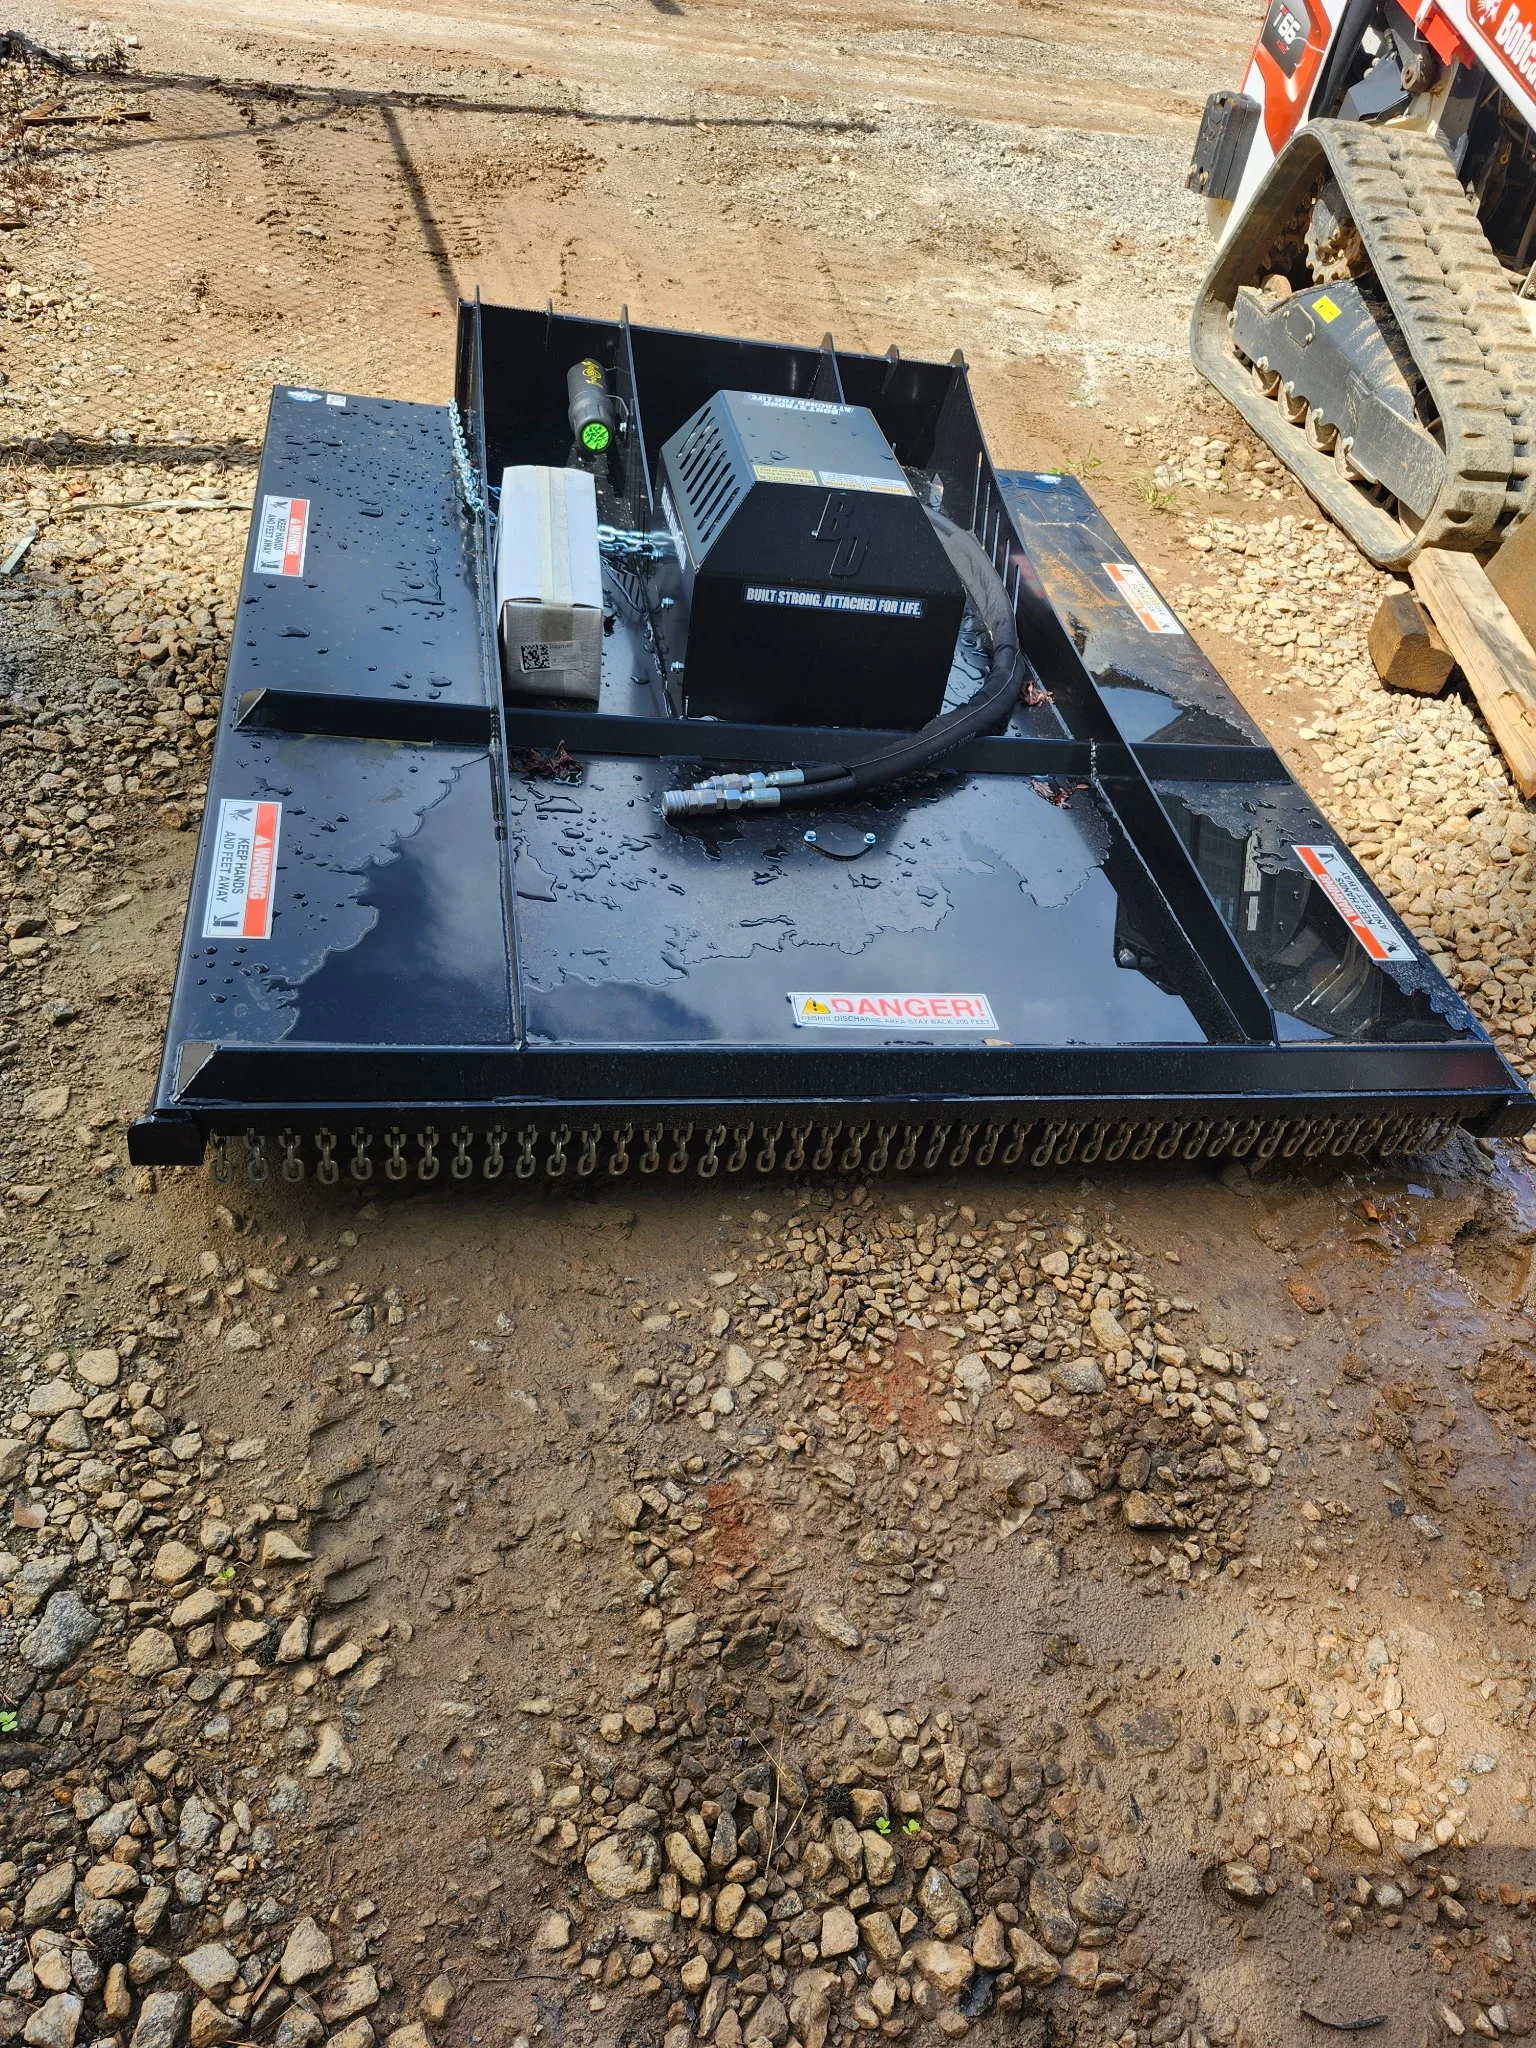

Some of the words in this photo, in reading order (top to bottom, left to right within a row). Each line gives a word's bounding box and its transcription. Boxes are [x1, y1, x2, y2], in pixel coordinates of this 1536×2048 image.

[267, 514, 276, 526] AND
[276, 518, 286, 534] KEEP
[265, 526, 274, 538] FEET
[274, 533, 284, 551] HANDS
[287, 526, 302, 554] WARNING
[262, 538, 272, 554] AWAY
[746, 587, 777, 602] BUILT
[778, 590, 822, 606] STRONG.
[824, 594, 877, 611] ATTACHED
[878, 600, 899, 613] FOR
[899, 601, 921, 616] LIFE.
[222, 830, 236, 848] AND
[236, 838, 250, 862] KEEP
[220, 850, 233, 874] FEET
[232, 863, 248, 894] HANDS
[250, 848, 271, 900] WARNING
[1340, 871, 1359, 892] AWAY
[216, 876, 230, 903] AWAY
[1318, 874, 1358, 918] WARNING
[1335, 878, 1358, 905] HANDS
[1356, 894, 1376, 913] FEET
[1355, 904, 1376, 925] KEEP
[1372, 915, 1388, 930] AND
[830, 998, 986, 1017] DANGER!
[834, 1015, 882, 1023] DISCHARGE
